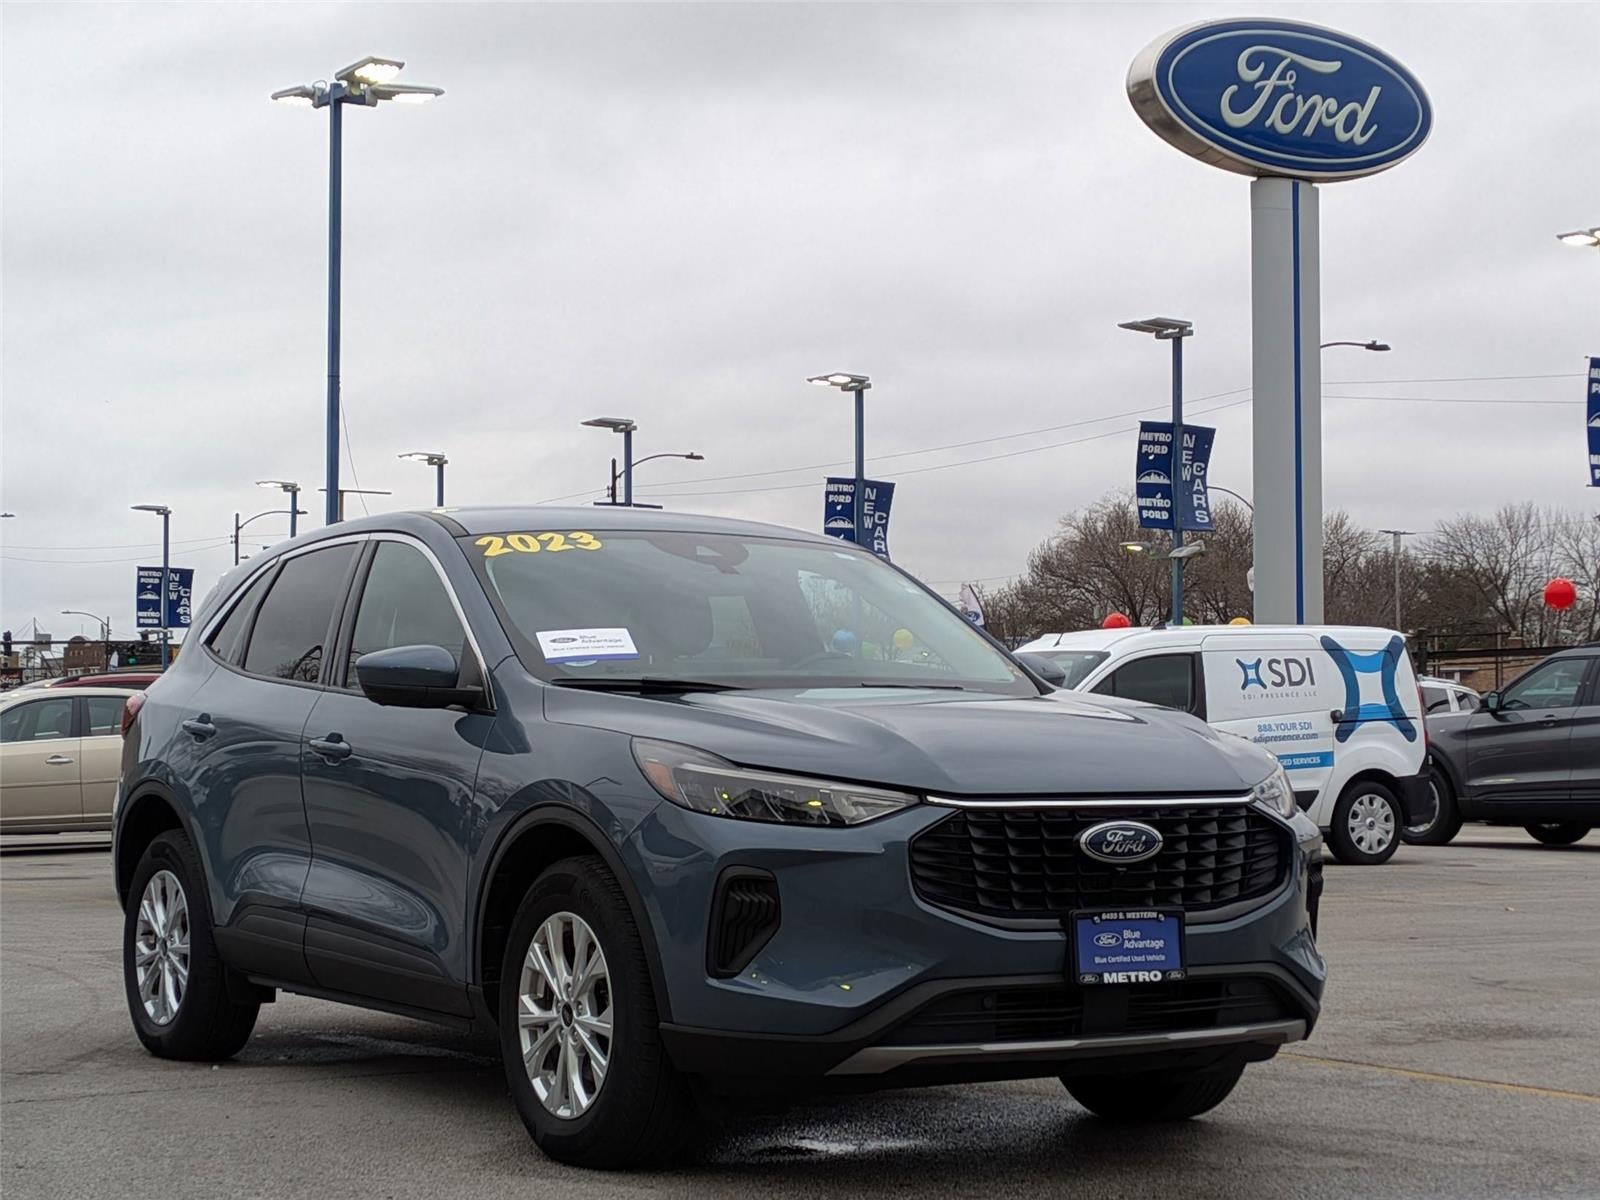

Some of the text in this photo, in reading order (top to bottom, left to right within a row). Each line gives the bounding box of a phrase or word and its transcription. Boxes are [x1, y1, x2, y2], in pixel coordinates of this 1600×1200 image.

[1221, 45, 1382, 145] Ford
[1139, 431, 1172, 442] METRO
[1141, 444, 1168, 454] FORD
[1182, 433, 1196, 481] NEW
[826, 483, 855, 493] METRO
[1193, 462, 1210, 523] CARS
[828, 494, 852, 504] FORD
[1138, 498, 1171, 507] METRO
[863, 487, 877, 529] NEW
[1142, 509, 1169, 520] FORD
[475, 531, 602, 556] 2023
[169, 573, 180, 601] NEW
[1267, 657, 1316, 688] SDI
[1260, 691, 1300, 699] PRESENCE
[1257, 721, 1313, 733] 888.YOUR SDI
[1253, 733, 1319, 744] sdipresence.com
[1292, 756, 1321, 764] SERVICES
[1102, 829, 1147, 854] Ford
[1125, 911, 1158, 919] WESTERN
[1123, 929, 1141, 939] Blue
[1123, 939, 1164, 949] Advantage
[1107, 955, 1131, 963] Certified
[1131, 954, 1145, 962] Used
[1103, 970, 1162, 984] METRO
